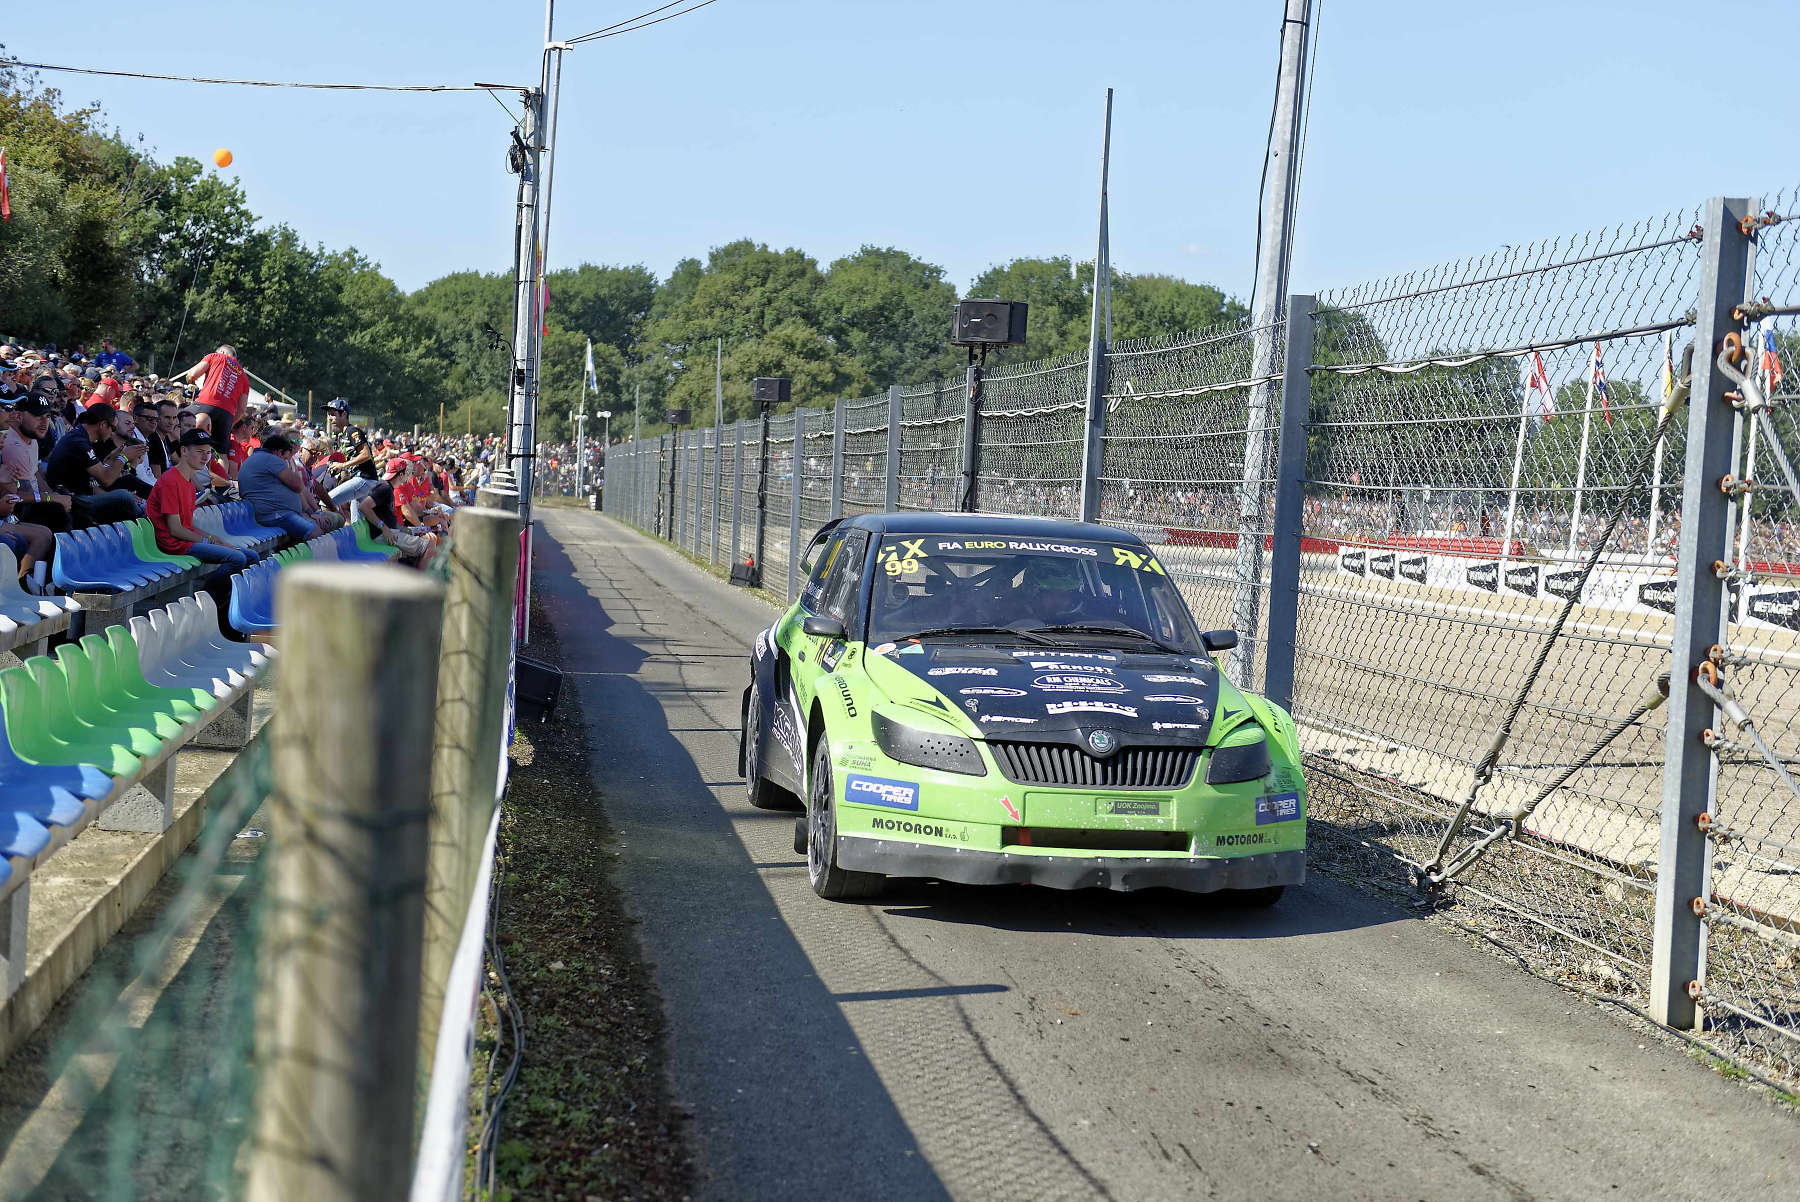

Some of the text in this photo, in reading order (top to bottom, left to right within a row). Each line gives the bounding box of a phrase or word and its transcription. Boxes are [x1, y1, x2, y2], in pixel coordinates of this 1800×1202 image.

[938, 541, 1098, 556] FIA EURO RALLYCROSS
[884, 558, 919, 577] 99
[851, 780, 914, 798] COOPER
[881, 793, 912, 804] TIRES
[872, 818, 944, 838] MOTORON
[1216, 833, 1264, 847] MOTORON
